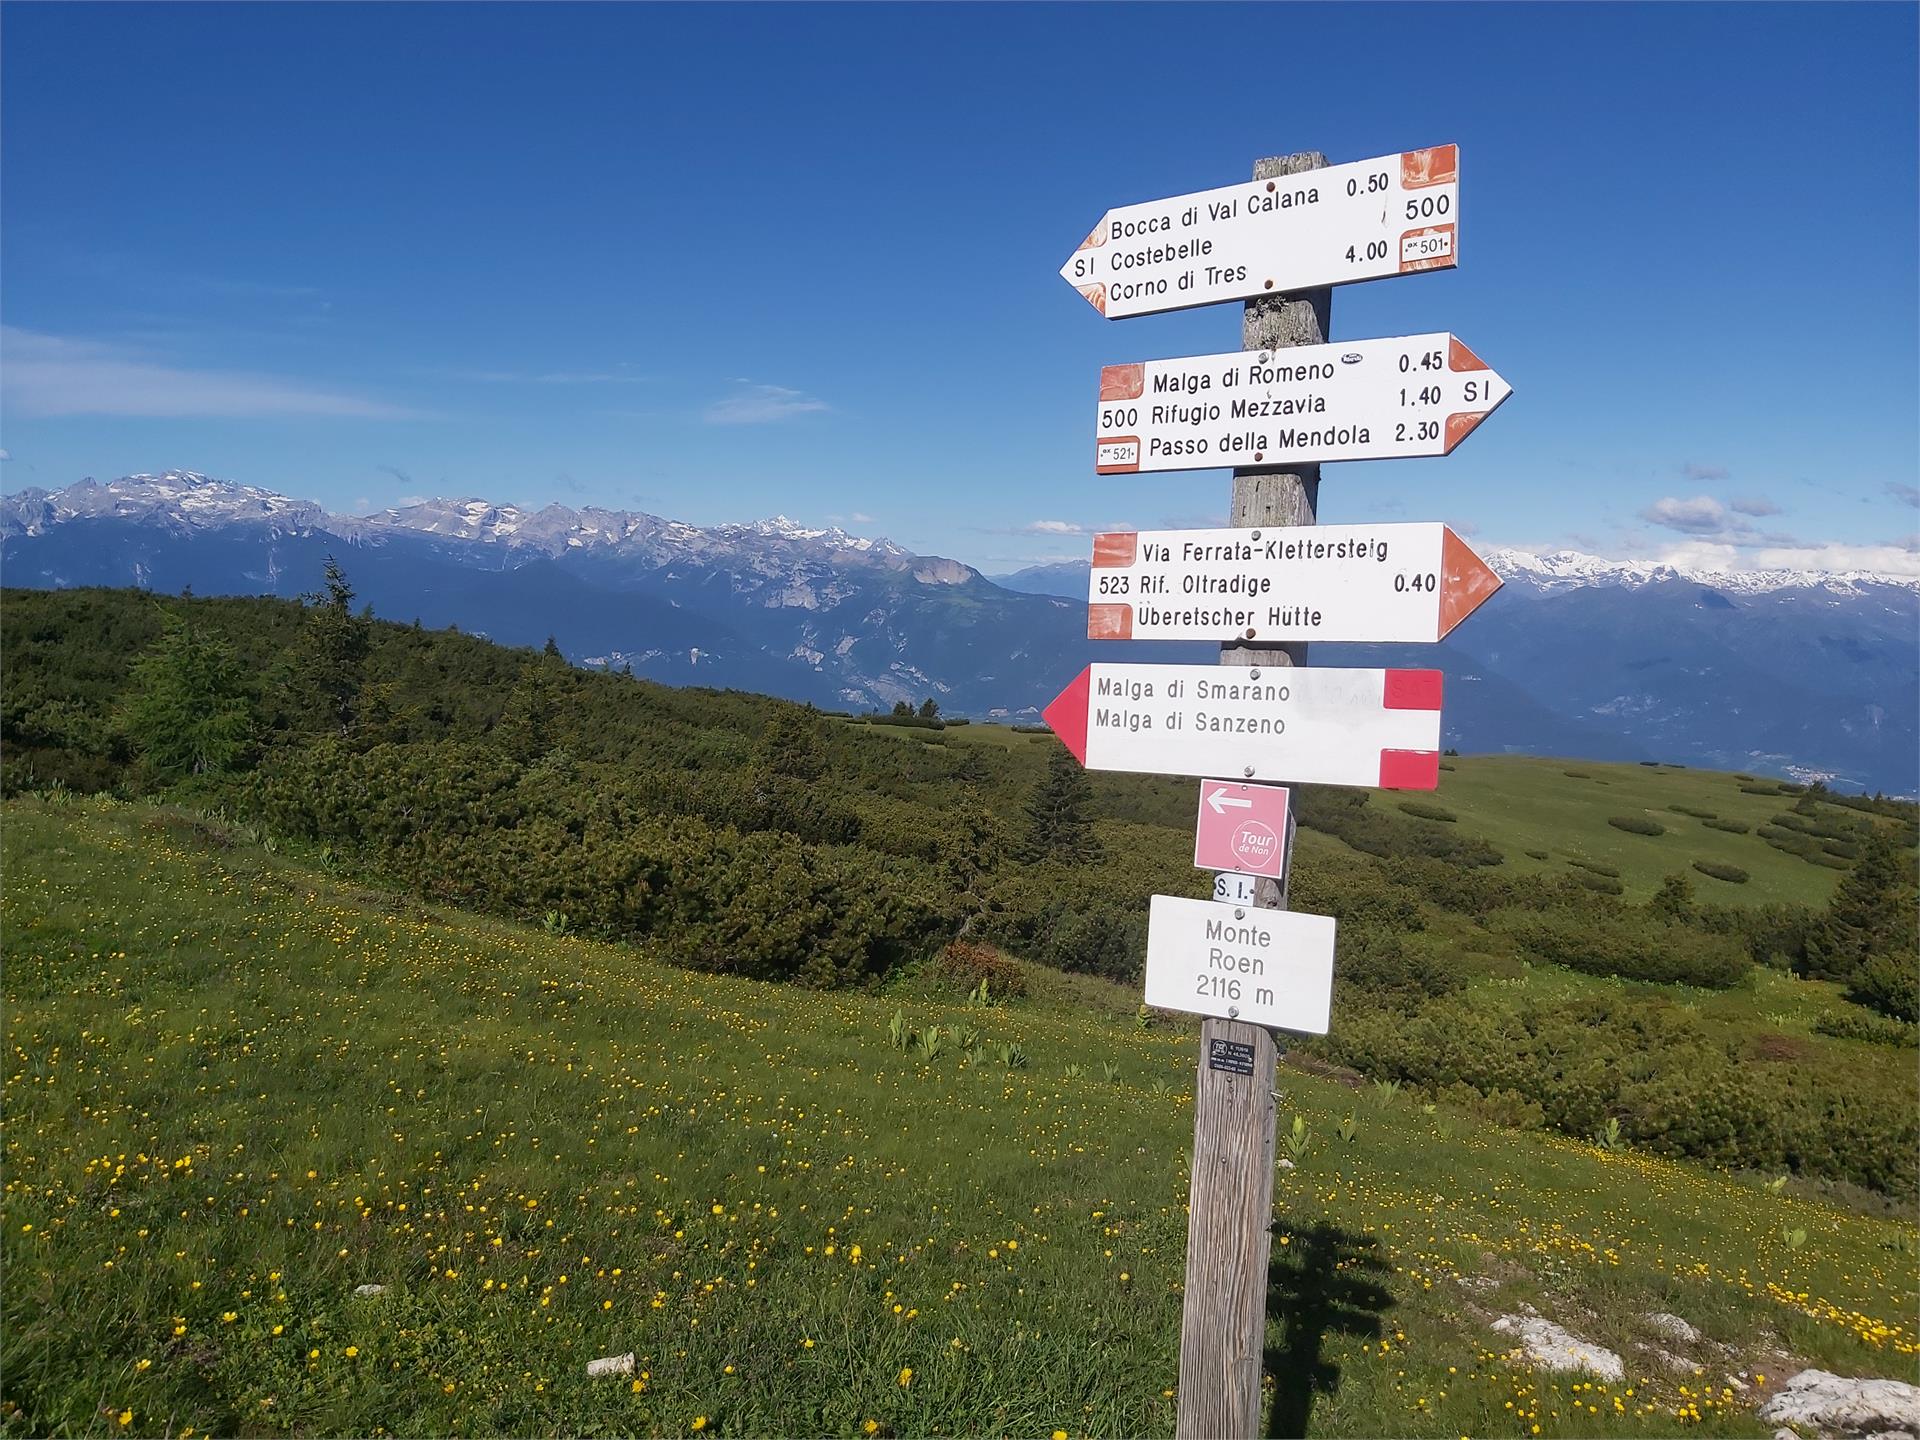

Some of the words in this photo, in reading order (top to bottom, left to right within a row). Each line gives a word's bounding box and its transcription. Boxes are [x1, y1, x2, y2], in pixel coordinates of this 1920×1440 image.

[1347, 173, 1388, 196] 0.50
[1112, 217, 1170, 239] Bocca
[1182, 207, 1197, 226] di
[1209, 200, 1236, 221] Val
[1248, 188, 1319, 214] Calana
[1406, 195, 1449, 220] 500
[1111, 239, 1213, 271] Costebelle
[1346, 241, 1387, 263] 4.00
[1420, 237, 1443, 254] 501
[1111, 279, 1167, 301] Corno
[1178, 271, 1193, 290] di
[1205, 266, 1246, 285] Tres
[1399, 351, 1442, 372] 0.45
[1154, 373, 1210, 394] Malga
[1223, 368, 1238, 387] di
[1250, 362, 1334, 385] Romeno
[1401, 386, 1441, 406] 1.40
[1102, 408, 1137, 428] 500
[1152, 403, 1220, 425] Rifugio
[1231, 396, 1325, 418] Mezzavia
[1151, 438, 1208, 456] Passo
[1220, 432, 1267, 452] della
[1280, 425, 1370, 448] Mendola
[1396, 421, 1439, 441] 2.30
[1113, 447, 1131, 460] 521
[1144, 544, 1169, 561] Via
[1184, 539, 1388, 562] Ferrata-Klettersteig
[1100, 576, 1129, 594] 523
[1141, 576, 1169, 593] Rif.
[1183, 575, 1270, 597] Oltradige
[1395, 574, 1435, 592] 0.40
[1139, 601, 1254, 625] Überetscher
[1269, 605, 1321, 626] Hütte
[1098, 678, 1153, 700] Malga
[1168, 680, 1183, 698] di
[1197, 680, 1289, 701] Smarano
[1097, 709, 1151, 732] Malga
[1166, 712, 1182, 730] di
[1196, 712, 1284, 734] Sanzeno
[1238, 844, 1249, 852] de
[1251, 846, 1269, 855] Non
[1241, 831, 1273, 846] Tour
[1206, 919, 1270, 947] Monte
[1210, 948, 1263, 975] Roen
[1197, 975, 1240, 1000] 2116
[1256, 988, 1273, 1006] m
